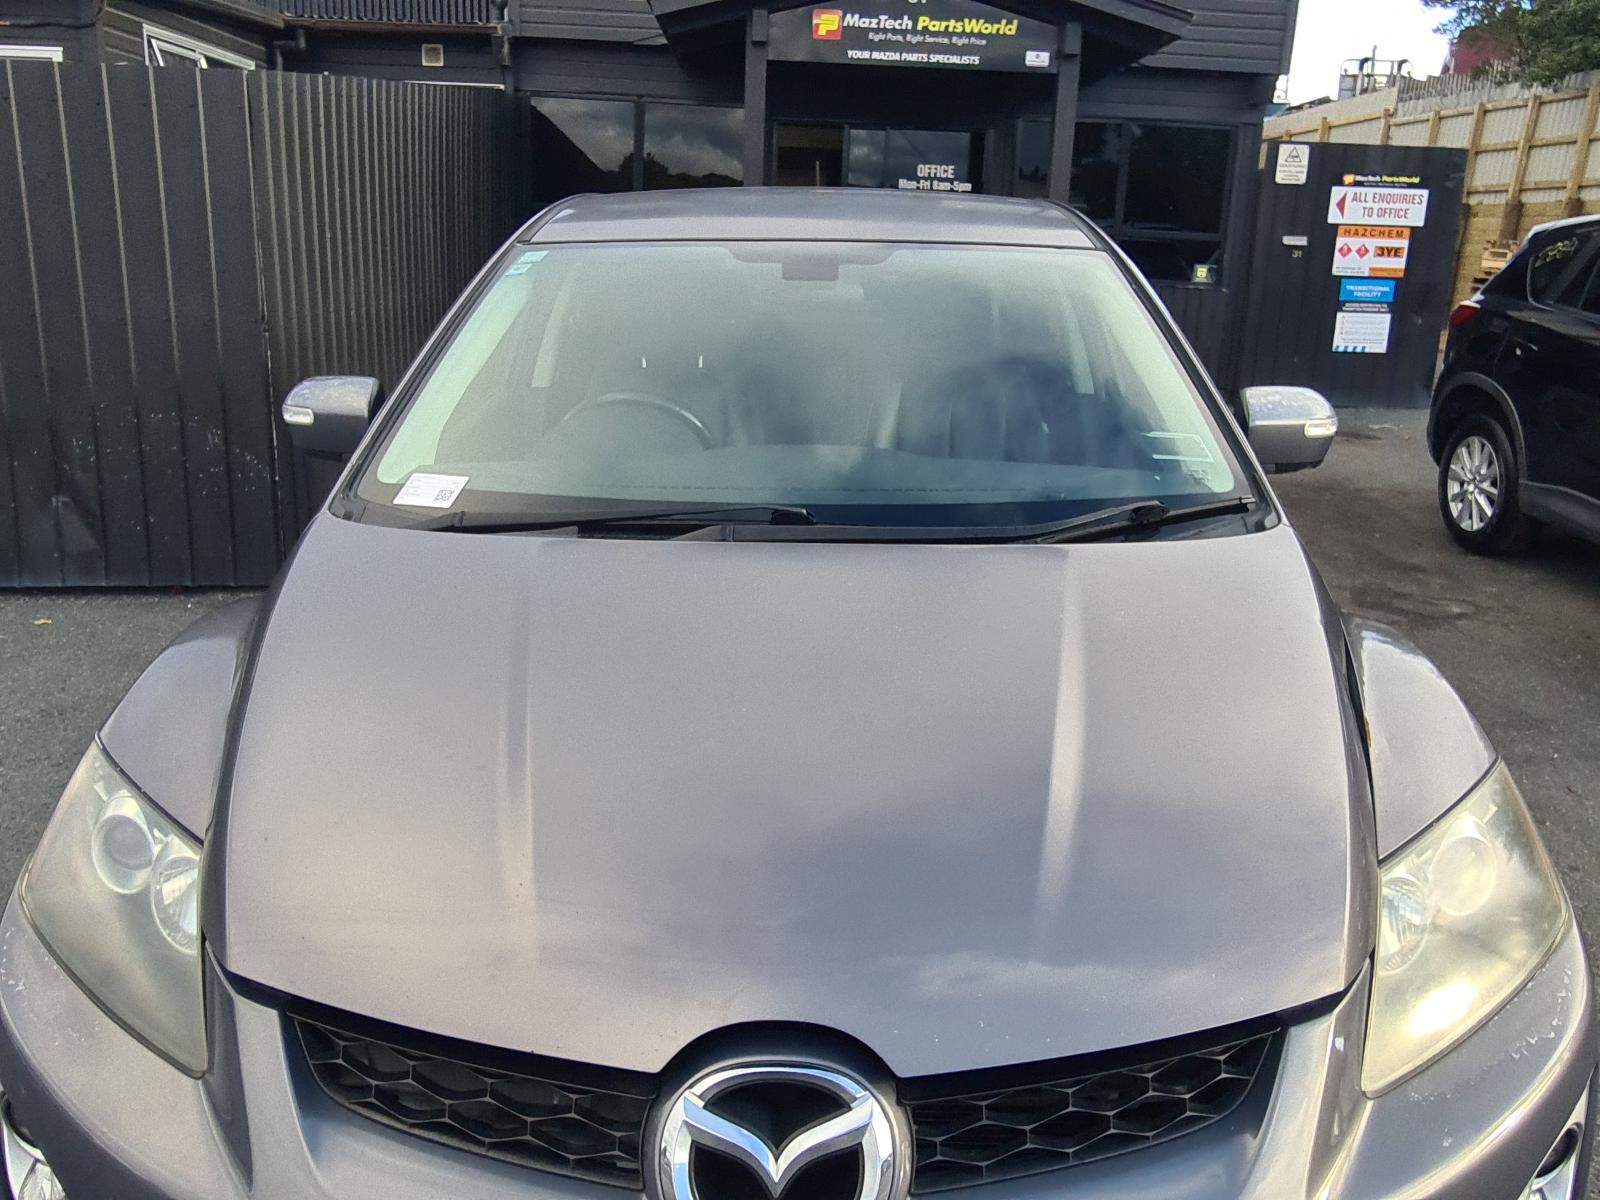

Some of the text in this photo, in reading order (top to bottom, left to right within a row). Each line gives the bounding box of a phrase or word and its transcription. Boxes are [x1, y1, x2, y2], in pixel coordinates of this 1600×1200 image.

[843, 13, 1018, 36] MazTech PartsWorld
[868, 32, 885, 42] Right
[906, 34, 924, 44] Right
[952, 36, 969, 46] Right
[970, 37, 987, 46] Price
[847, 50, 980, 65] YOUR MAZDA PARTS SPECIALISTS
[917, 164, 955, 178] OFFICE
[1351, 192, 1425, 205] ALL ENQUIRIES
[1362, 207, 1410, 219] TO OFFICE
[1343, 228, 1404, 238] HAZCHEM
[1376, 247, 1402, 257] 3YE
